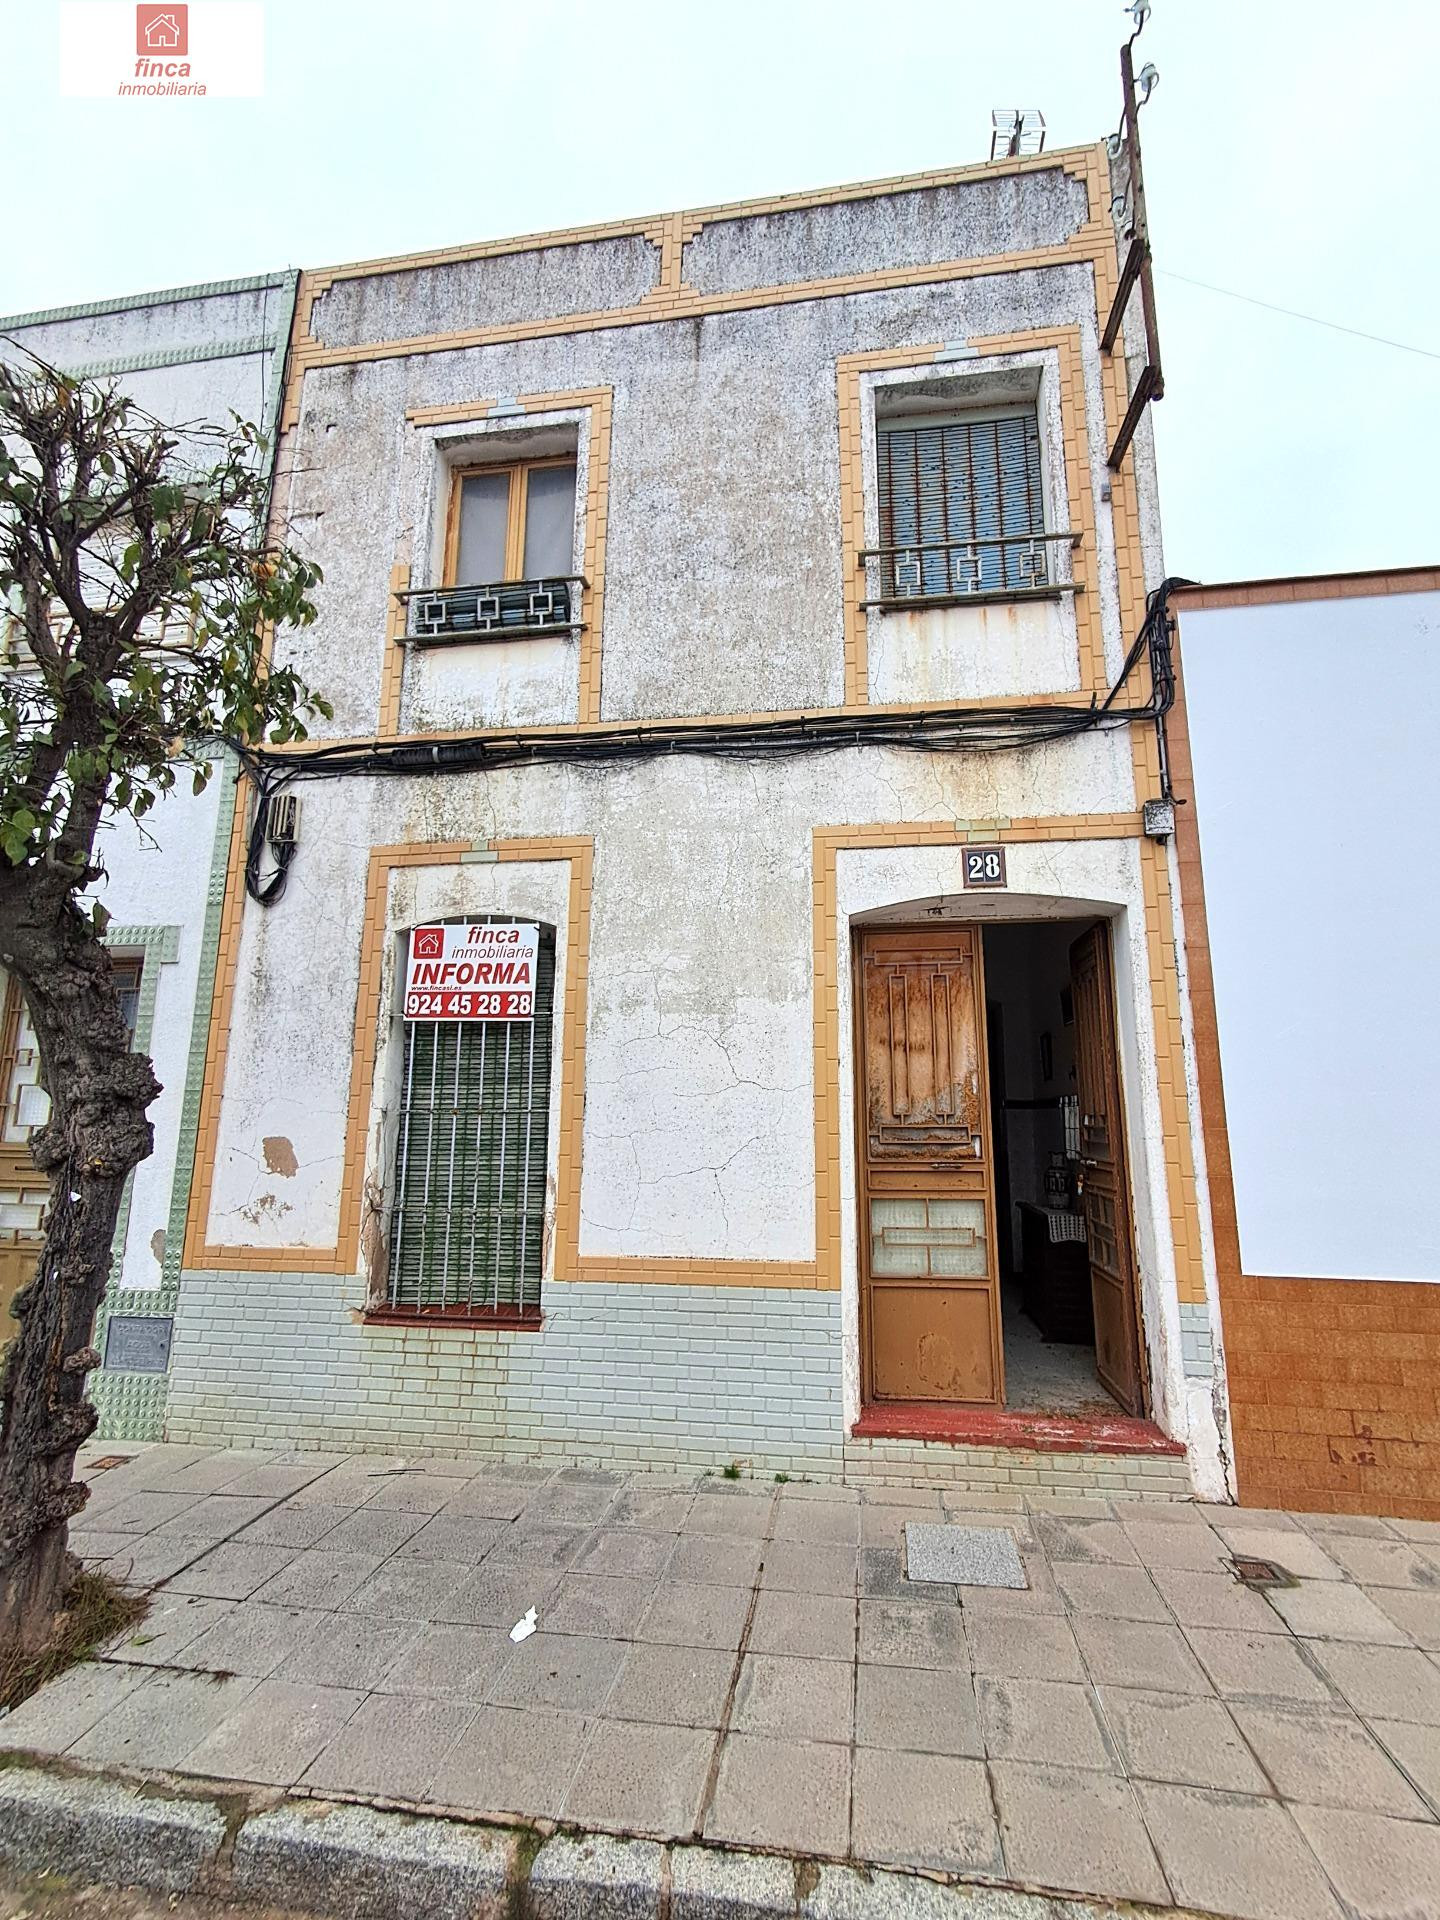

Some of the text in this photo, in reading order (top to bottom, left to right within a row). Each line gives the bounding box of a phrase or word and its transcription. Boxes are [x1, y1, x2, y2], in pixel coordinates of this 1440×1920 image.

[968, 853, 1000, 879] 28
[467, 926, 520, 944] finca
[451, 945, 534, 959] inmobiliaria
[411, 962, 531, 985] INFORMA
[408, 994, 531, 1015] 924 45 28 28
